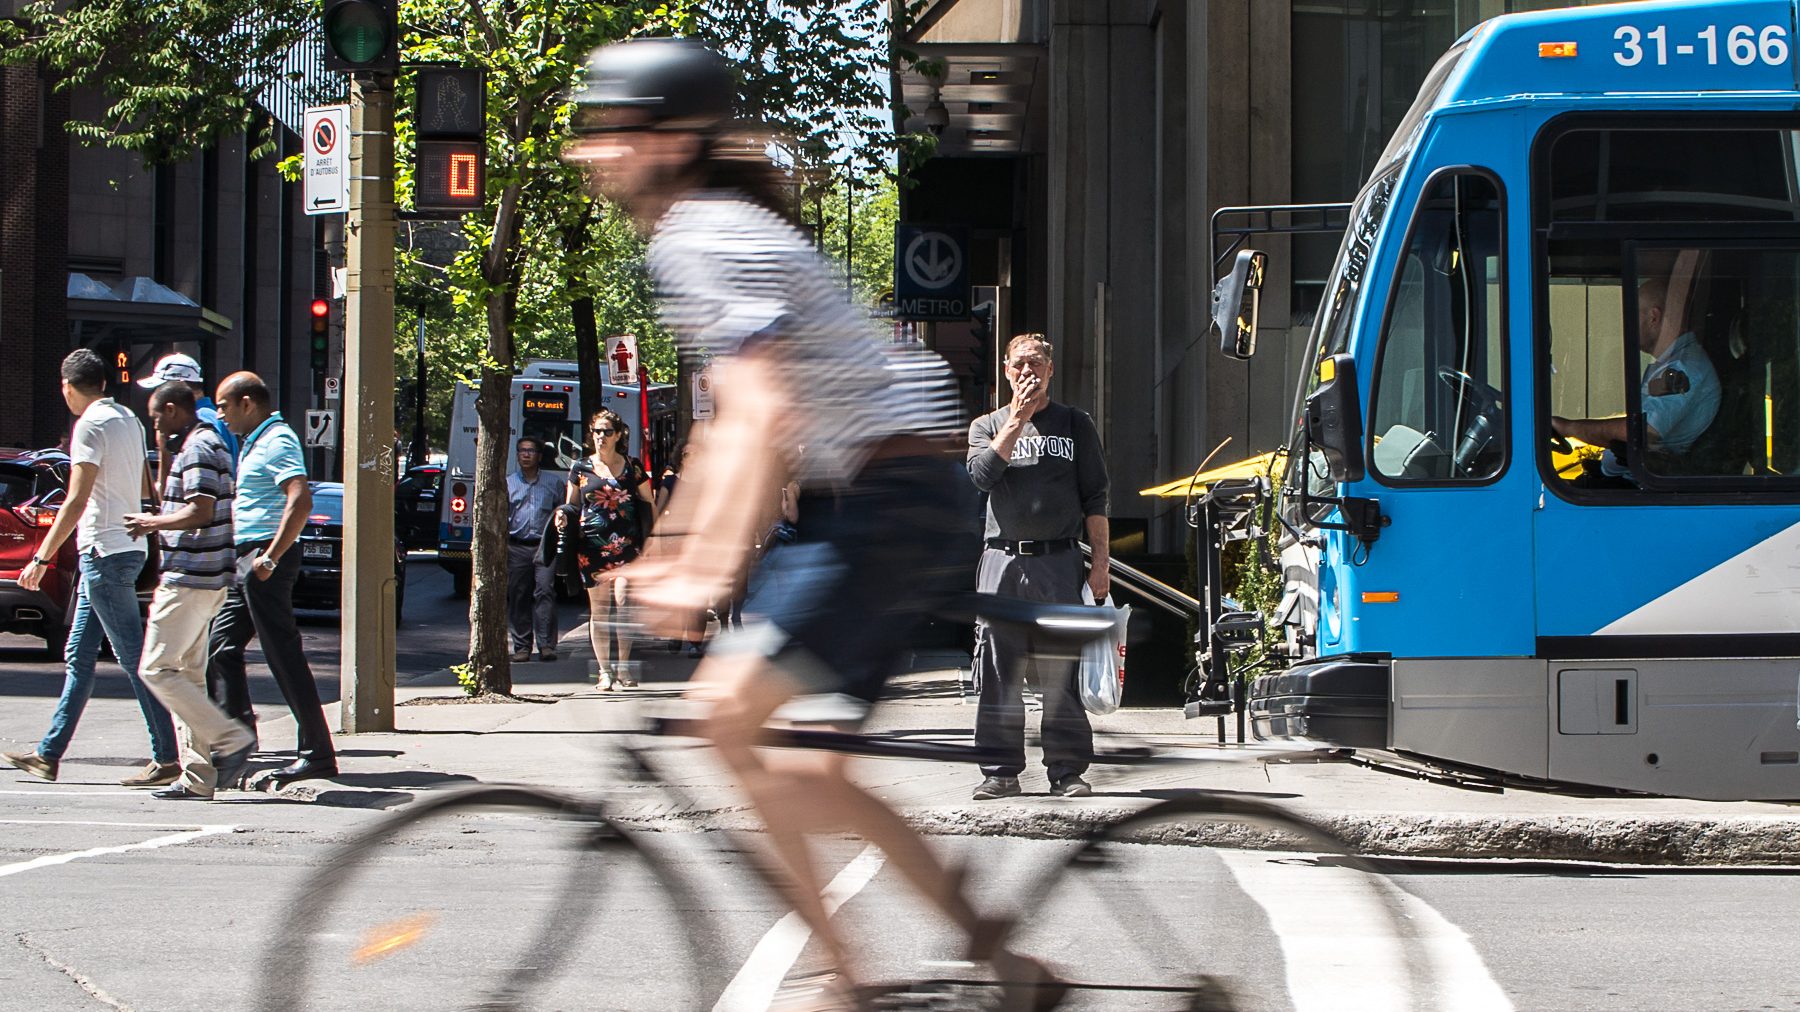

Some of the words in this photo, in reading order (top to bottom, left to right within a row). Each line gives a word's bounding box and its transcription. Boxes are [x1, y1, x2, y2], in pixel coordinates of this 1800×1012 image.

[1613, 25, 1788, 66] 31-166
[316, 157, 333, 167] ARRÊT
[451, 154, 476, 196] 0
[901, 298, 964, 316] METRO
[526, 400, 536, 408] En
[537, 401, 564, 410] transit
